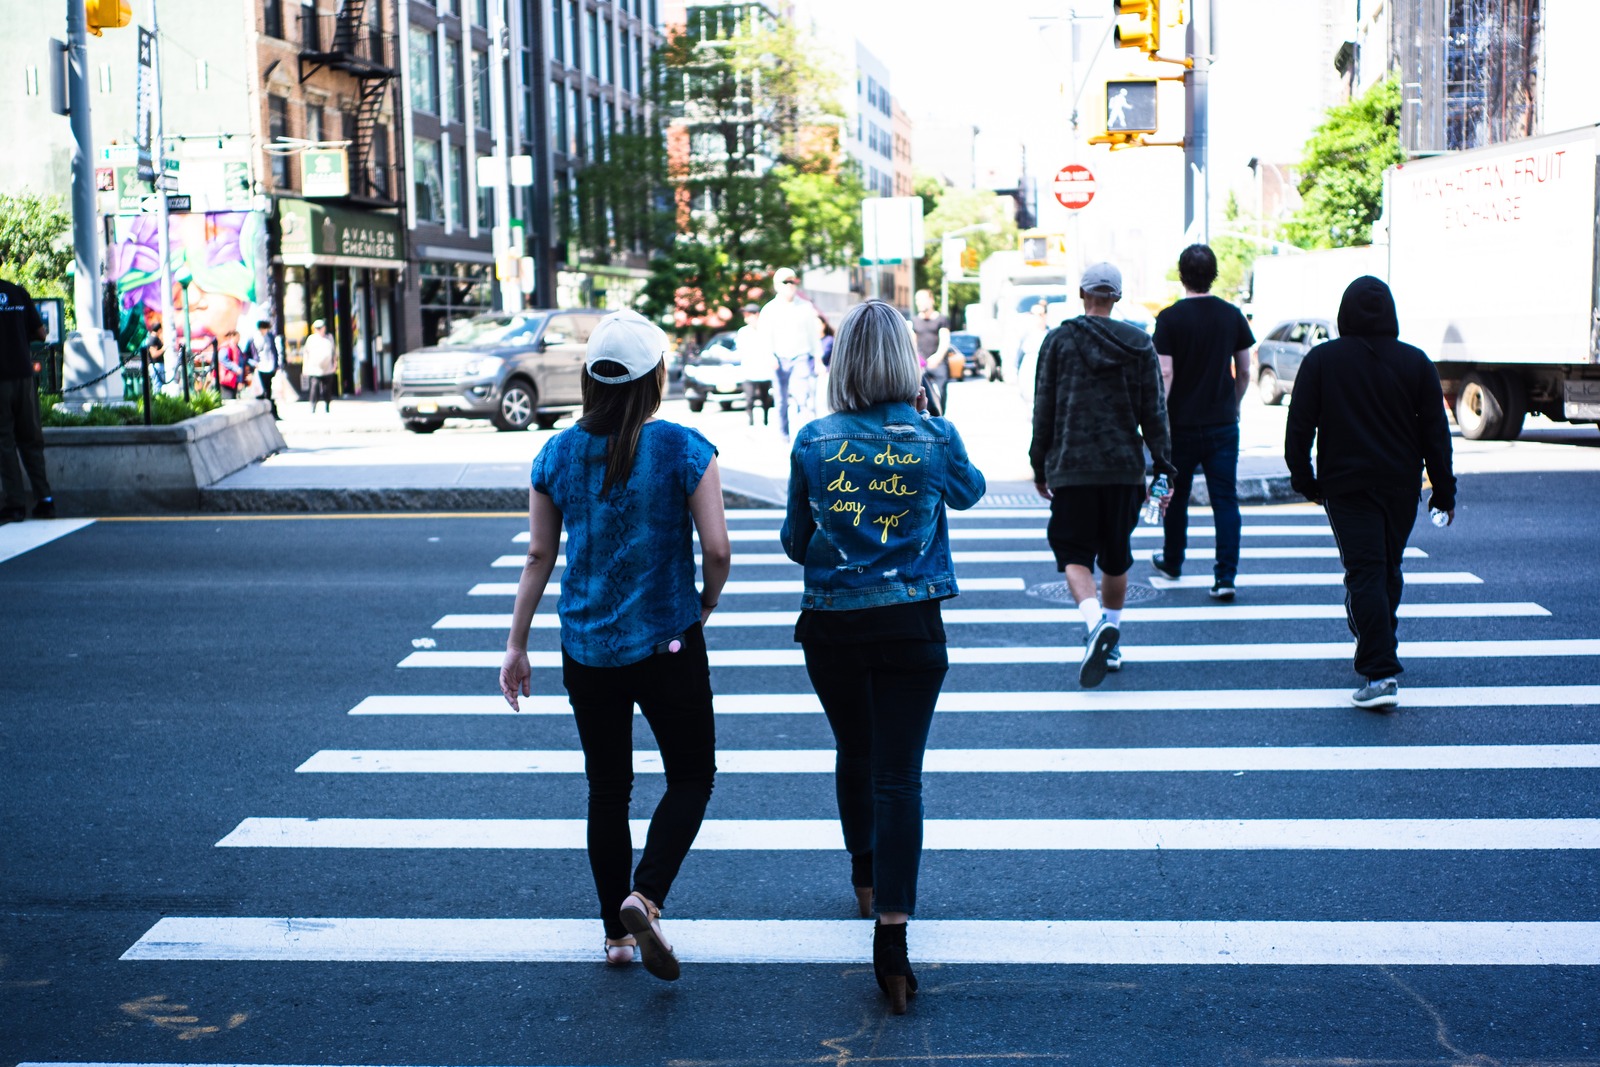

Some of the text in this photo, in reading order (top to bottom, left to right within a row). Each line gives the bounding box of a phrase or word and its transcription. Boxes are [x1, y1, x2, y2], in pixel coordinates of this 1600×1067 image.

[1413, 151, 1566, 201] MANHATTAN FRUIT
[342, 227, 395, 244] AVALON
[342, 241, 395, 258] CHEMISTS
[825, 440, 865, 463] la
[827, 470, 917, 496] de arte
[829, 499, 910, 544] soy yo
